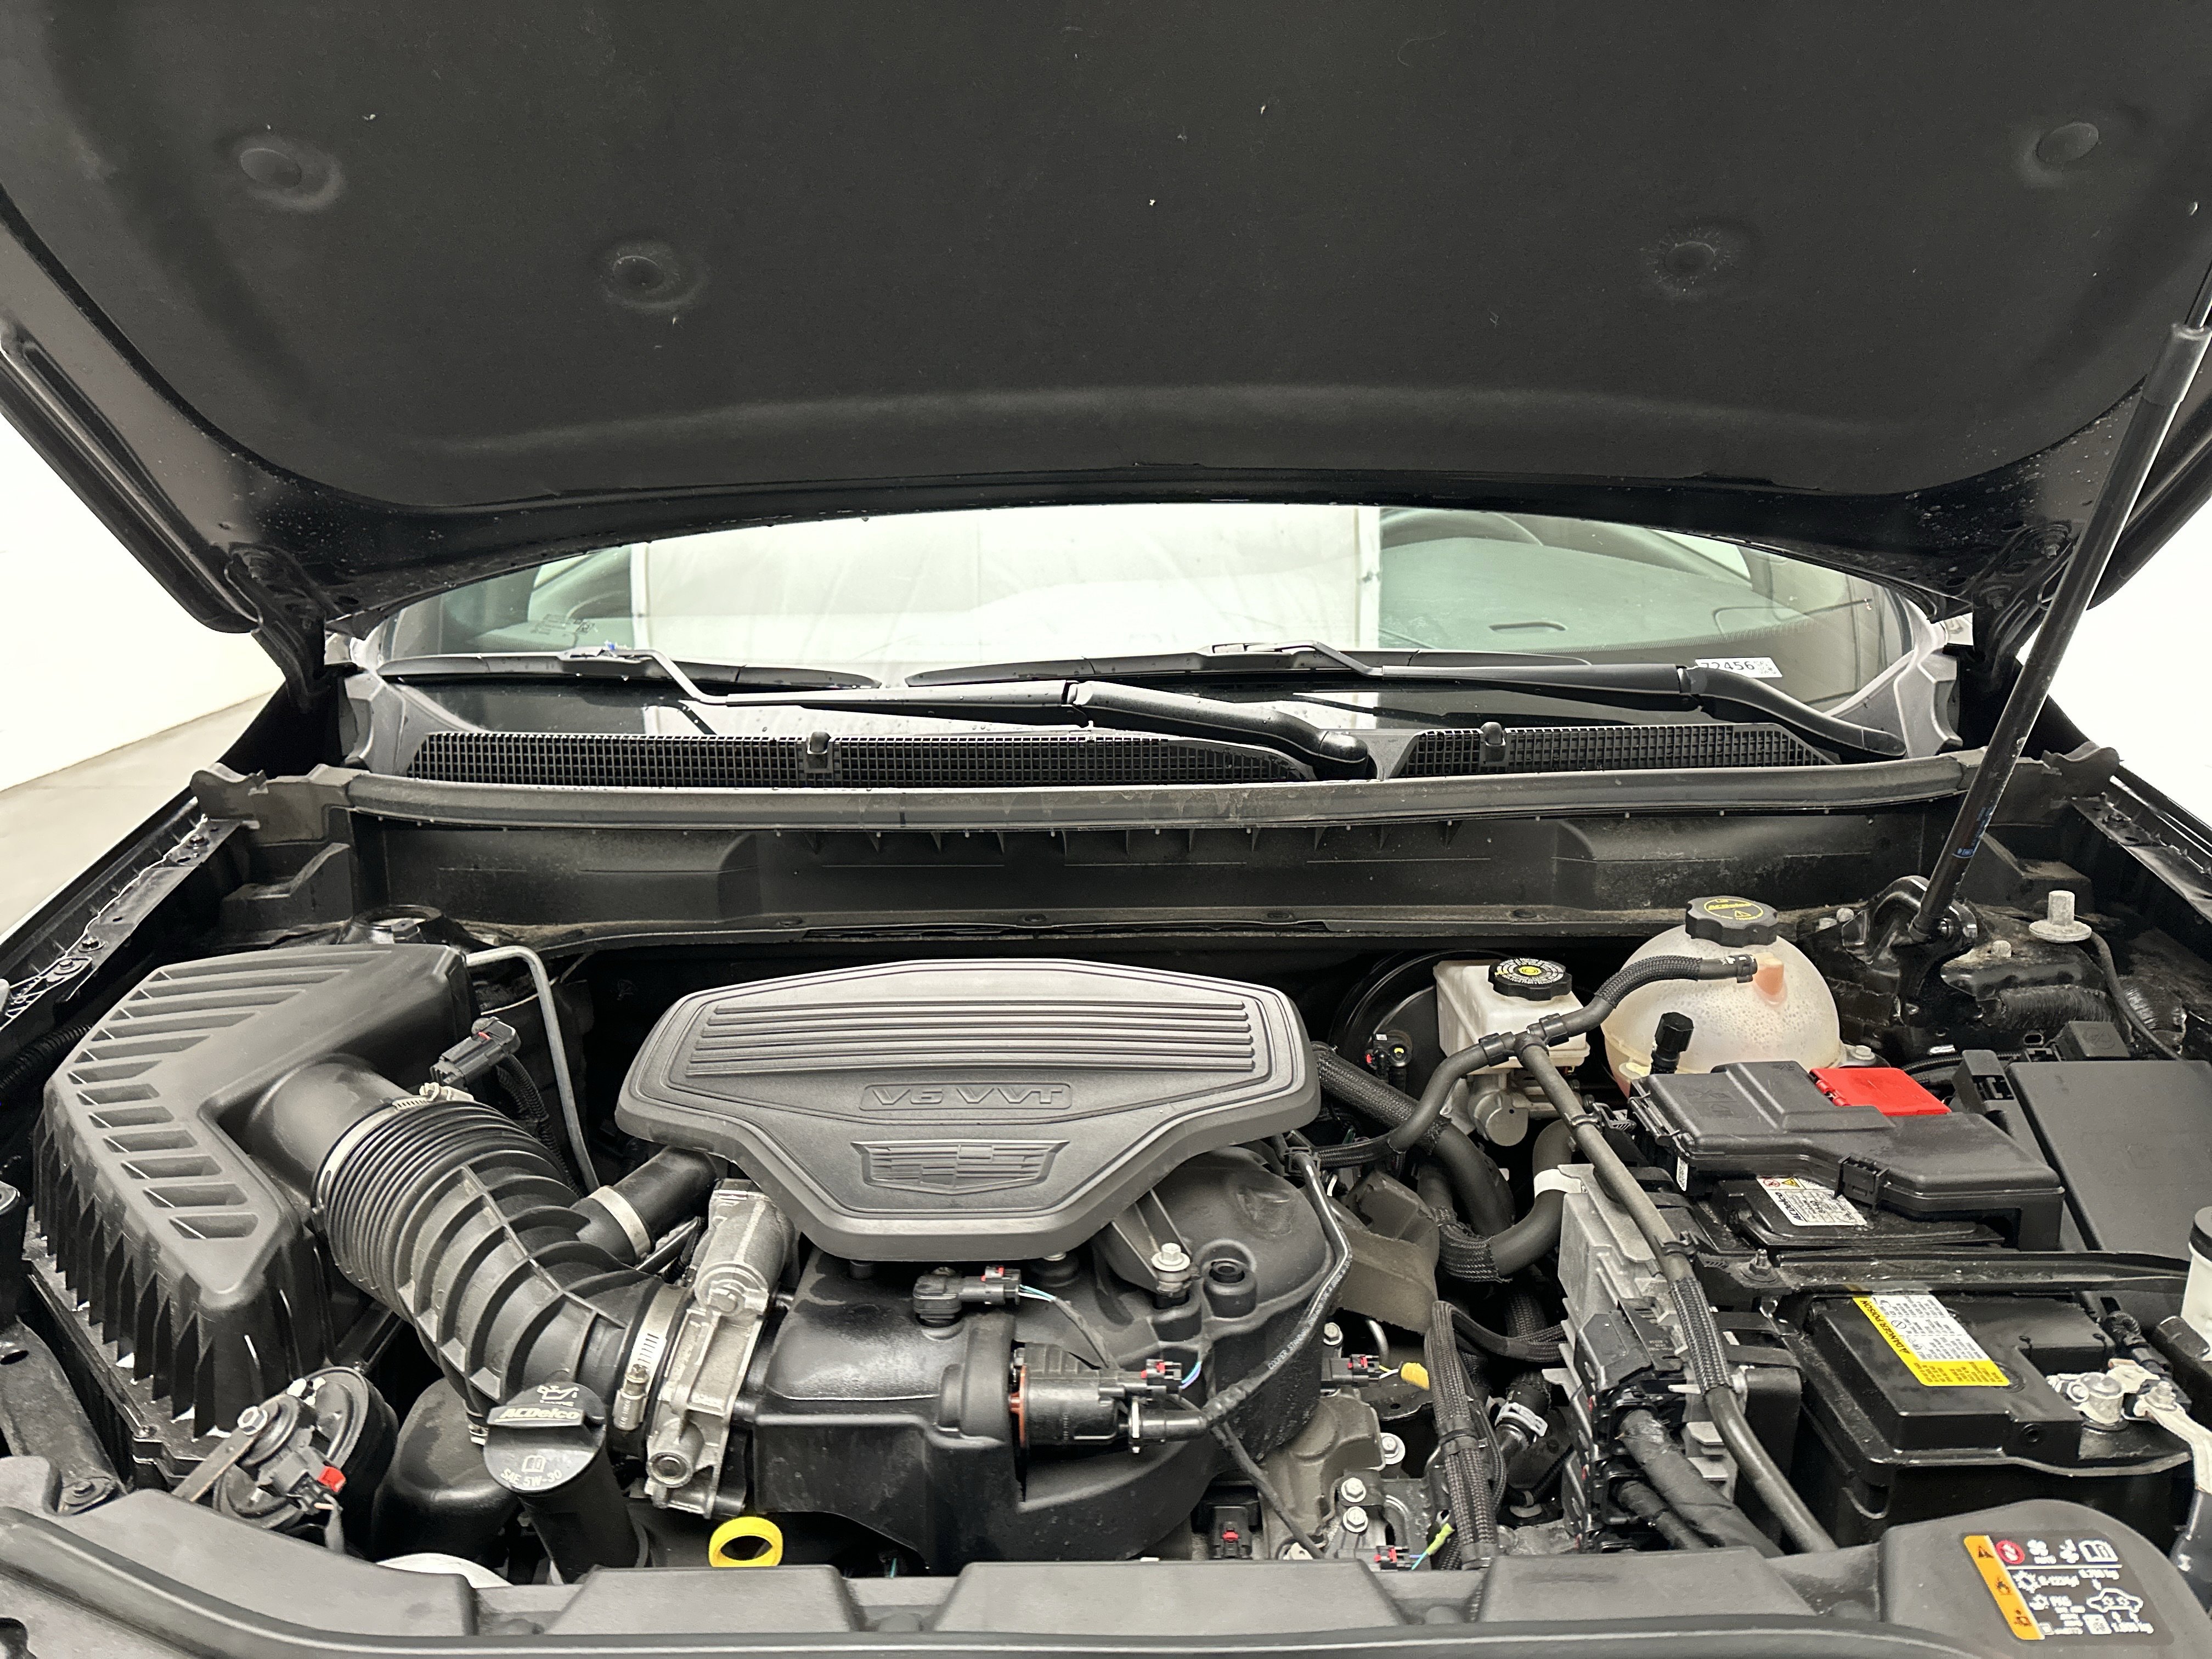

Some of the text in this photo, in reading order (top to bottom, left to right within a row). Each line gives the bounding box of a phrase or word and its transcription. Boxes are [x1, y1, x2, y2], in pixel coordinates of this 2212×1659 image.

[872, 1087, 1063, 1105] V6 VVT
[1775, 1192, 1804, 1221] ACDelco
[499, 1408, 580, 1420] ACDelco
[500, 1468, 562, 1487] SAE 5W-30
